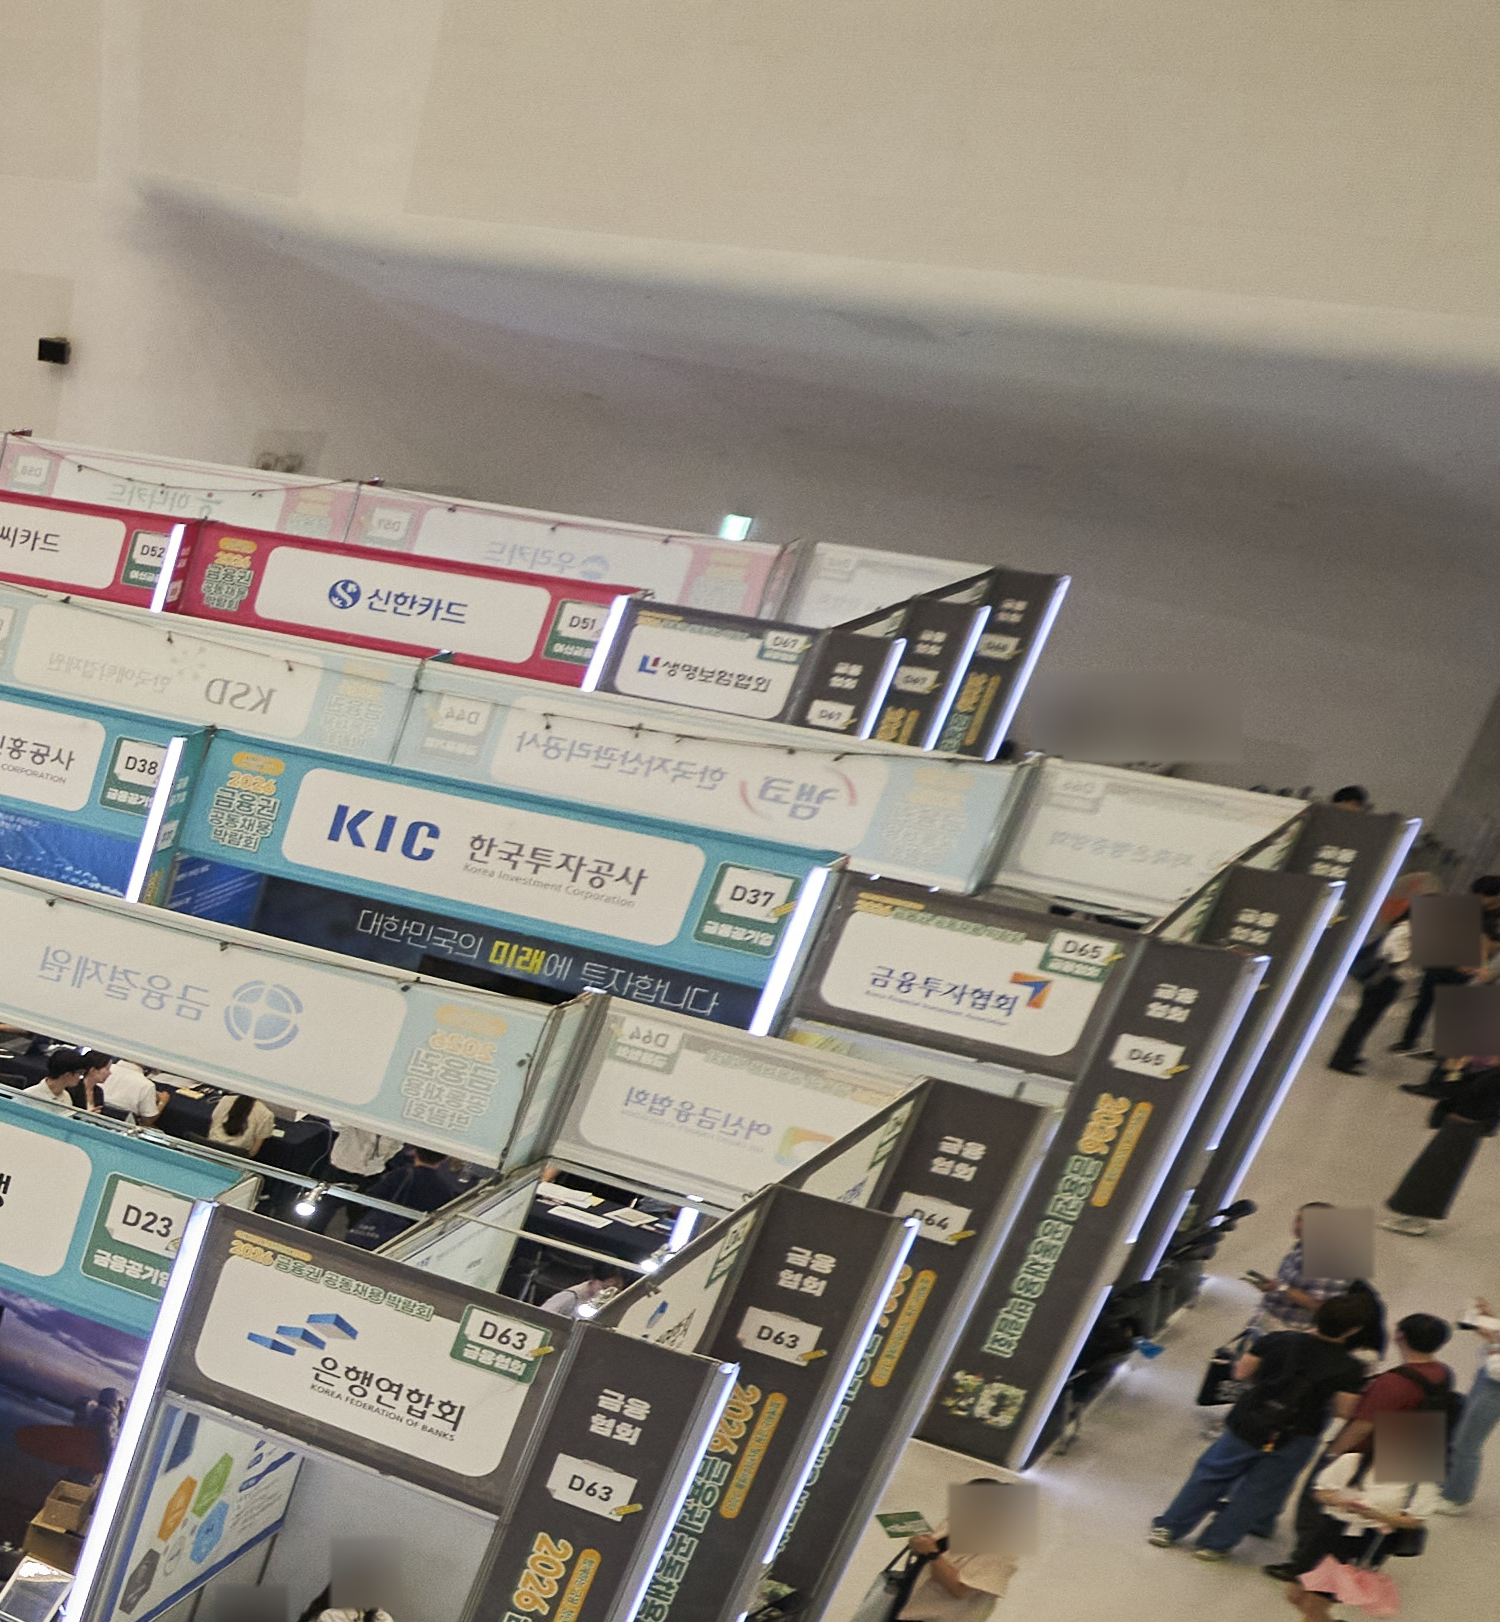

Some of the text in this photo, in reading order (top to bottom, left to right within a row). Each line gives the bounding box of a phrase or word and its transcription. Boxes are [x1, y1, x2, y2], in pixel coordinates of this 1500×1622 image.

[368, 588, 468, 625] 신한카드
[569, 615, 597, 632] D51
[662, 659, 771, 694] 생명보험협회
[124, 753, 158, 777] D38
[327, 802, 648, 896] KIC 한국투자공사
[730, 882, 777, 911] D37
[356, 909, 719, 1018] 대한민국의 미래에 투자합니다
[1063, 939, 1101, 960] D65
[869, 966, 1019, 1014] 금융투자협회
[938, 1134, 988, 1160] 금융
[929, 1152, 981, 1182] 협회
[123, 1205, 173, 1236] D23
[479, 1320, 528, 1351] D63
[310, 1352, 466, 1431] 은행연합회
[598, 1388, 651, 1419] 금융
[310, 1382, 455, 1441] KOREA FEDERATION BANKS
[588, 1410, 641, 1444] 협회
[568, 1472, 615, 1502] D63
